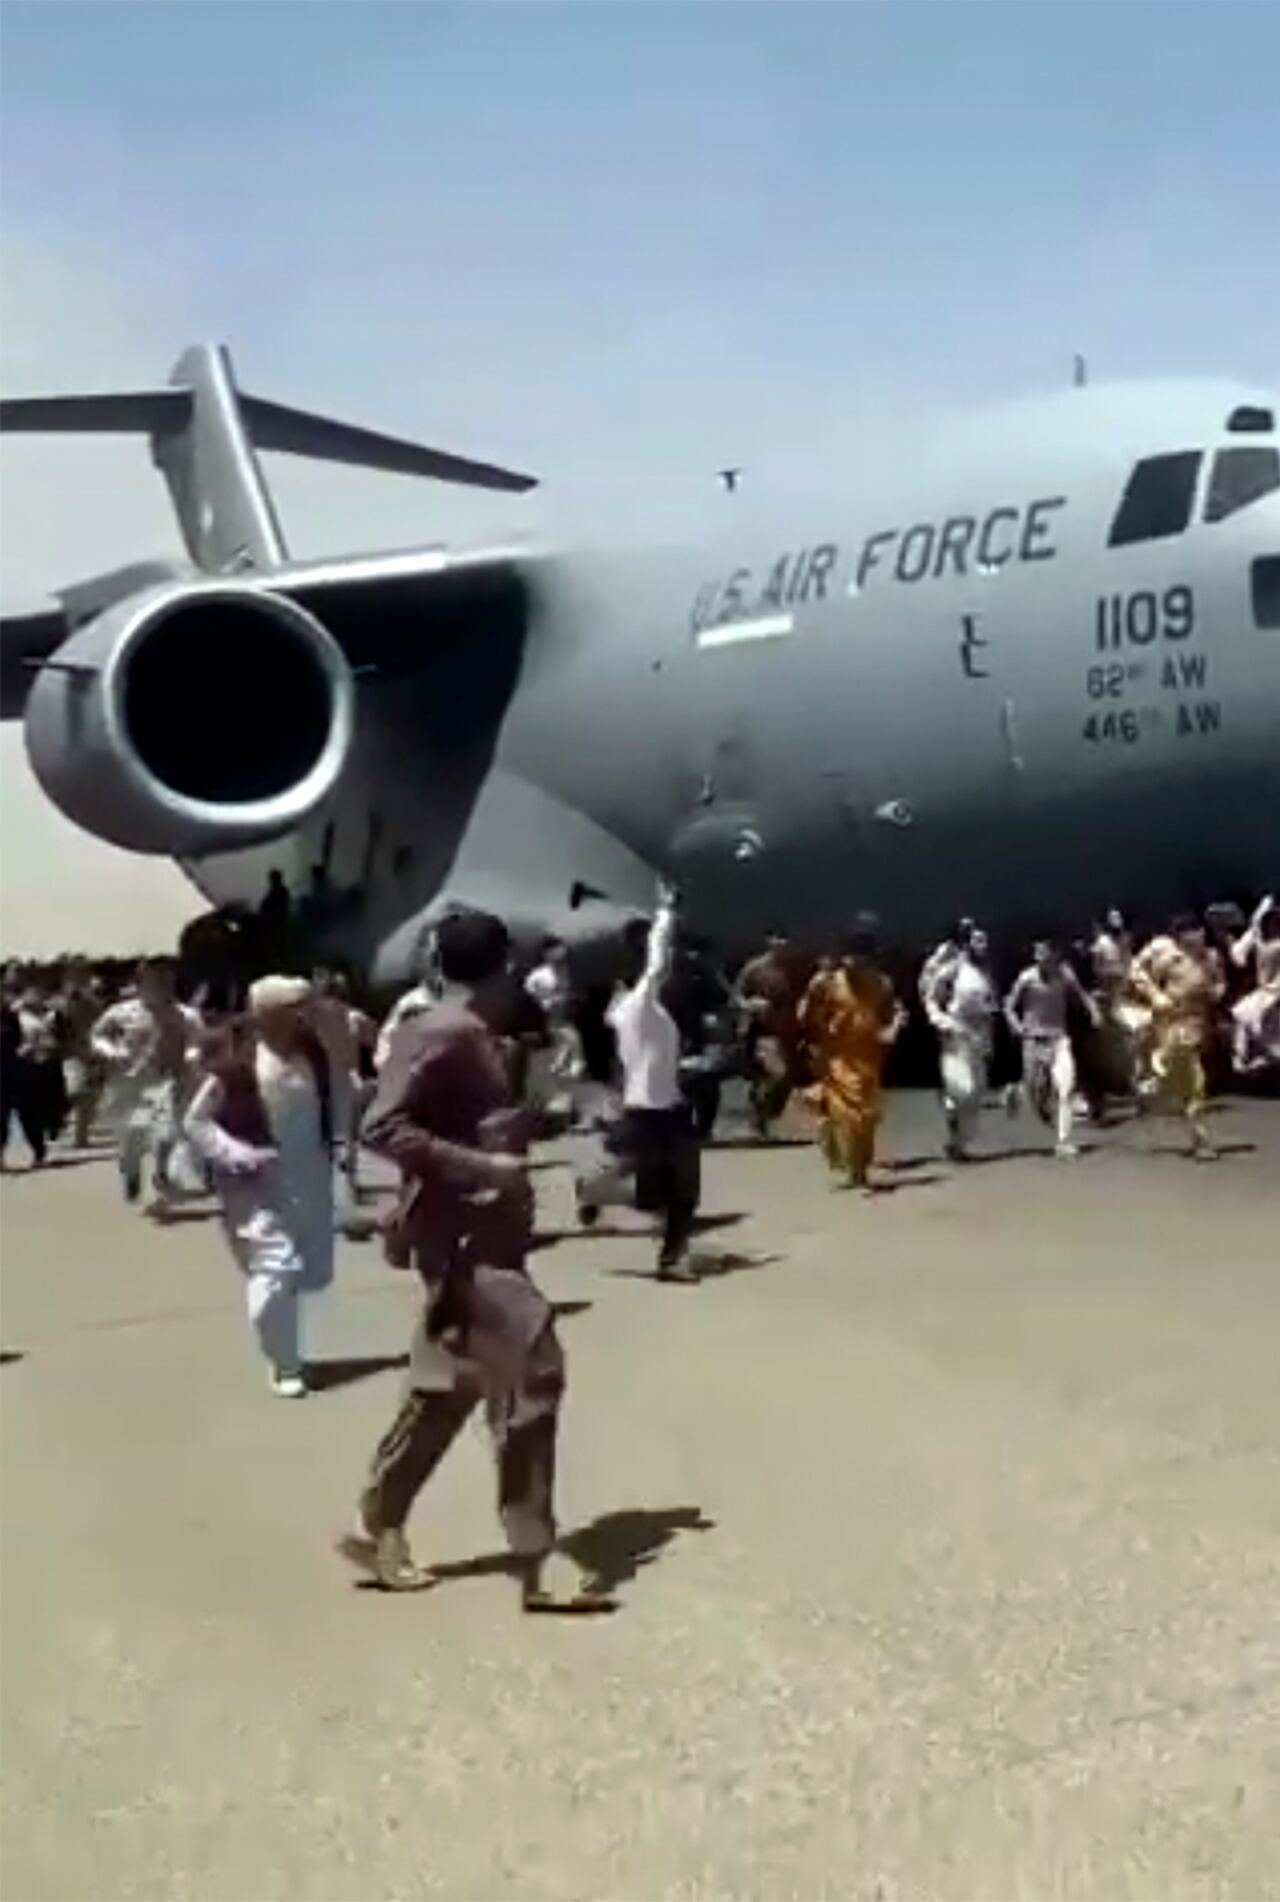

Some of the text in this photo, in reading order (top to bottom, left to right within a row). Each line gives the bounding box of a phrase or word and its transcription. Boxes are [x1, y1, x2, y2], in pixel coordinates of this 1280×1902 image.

[758, 542, 839, 608] AIR
[856, 496, 1066, 589] FORCE
[1096, 584, 1194, 652] 1109
[1086, 652, 1206, 700] 62 AW
[1083, 701, 1222, 743] 446 AW
